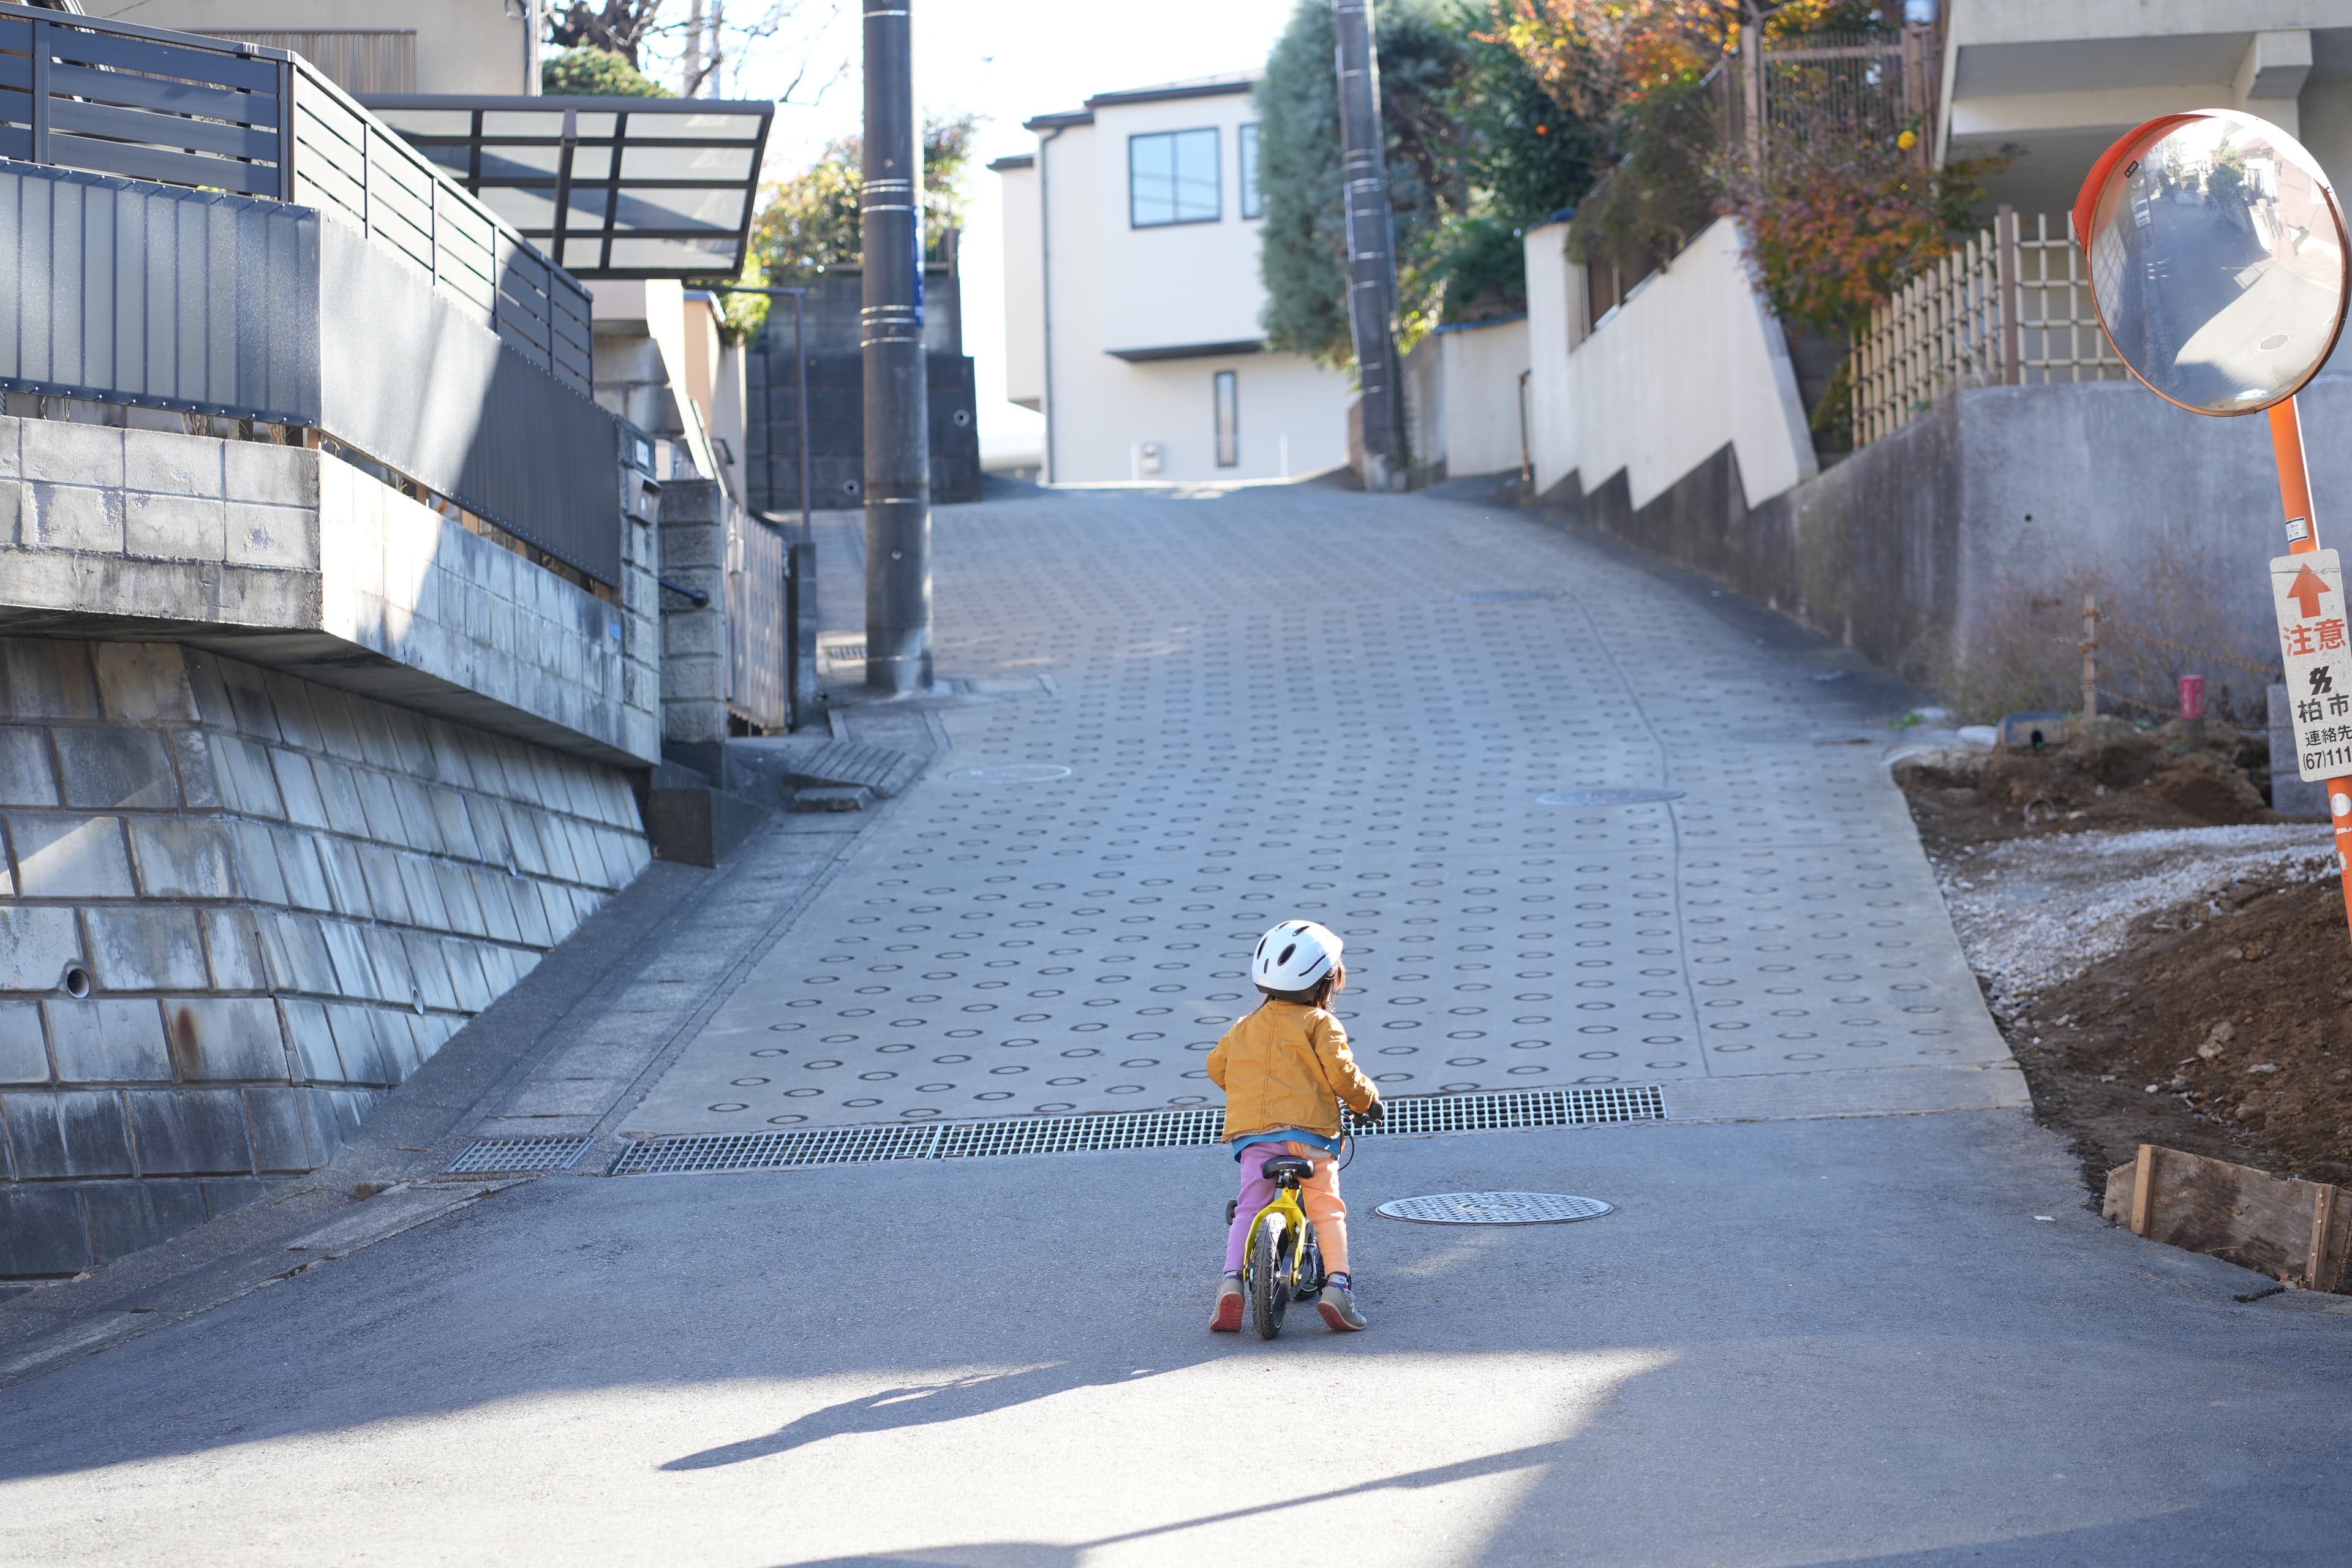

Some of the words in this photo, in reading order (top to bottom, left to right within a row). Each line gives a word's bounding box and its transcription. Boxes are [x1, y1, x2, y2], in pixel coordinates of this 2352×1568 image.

[2283, 619, 2346, 657] 注意
[2297, 693, 2349, 723] 柏市
[2305, 725, 2352, 746] 連絡先
